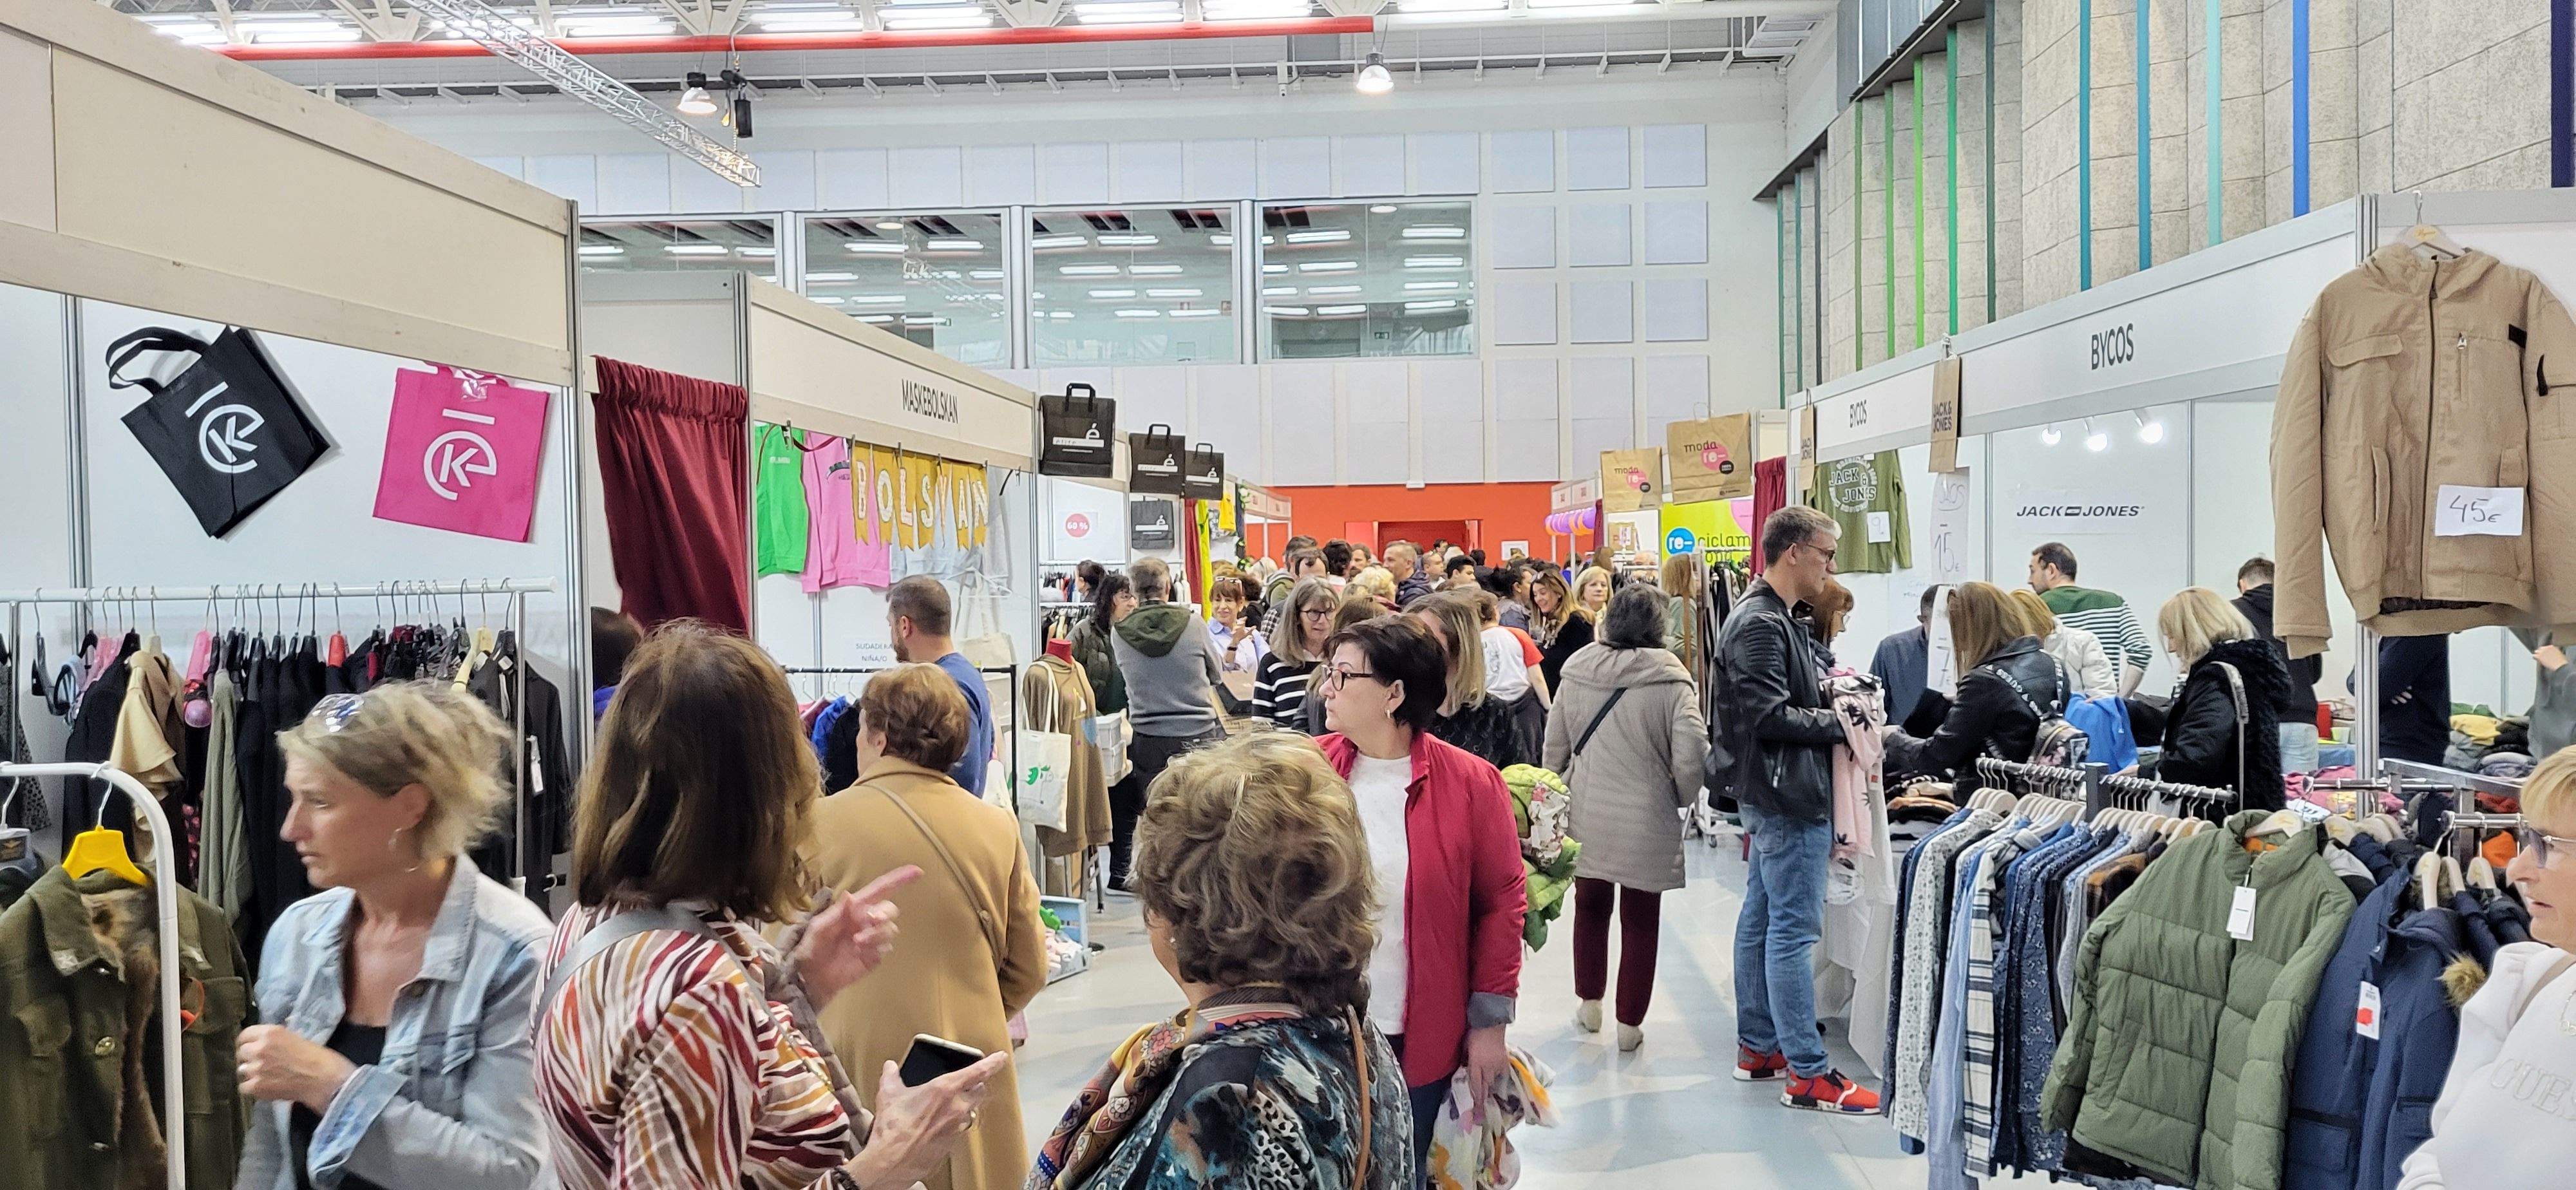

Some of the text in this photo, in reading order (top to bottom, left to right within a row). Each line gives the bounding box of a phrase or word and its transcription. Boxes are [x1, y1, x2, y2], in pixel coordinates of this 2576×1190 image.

[2091, 323, 2134, 371] BYCOS
[902, 378, 958, 424] MASKEBOLSKAN
[1849, 399, 1868, 428] BYCOS
[1933, 416, 1953, 433] JONES
[1683, 440, 1718, 453] moda
[1614, 466, 1640, 474] moda
[1829, 467, 1859, 486] JACK
[1842, 486, 1877, 502] JONS
[2016, 505, 2140, 517] JACK JONES
[2449, 495, 2502, 524] 45€
